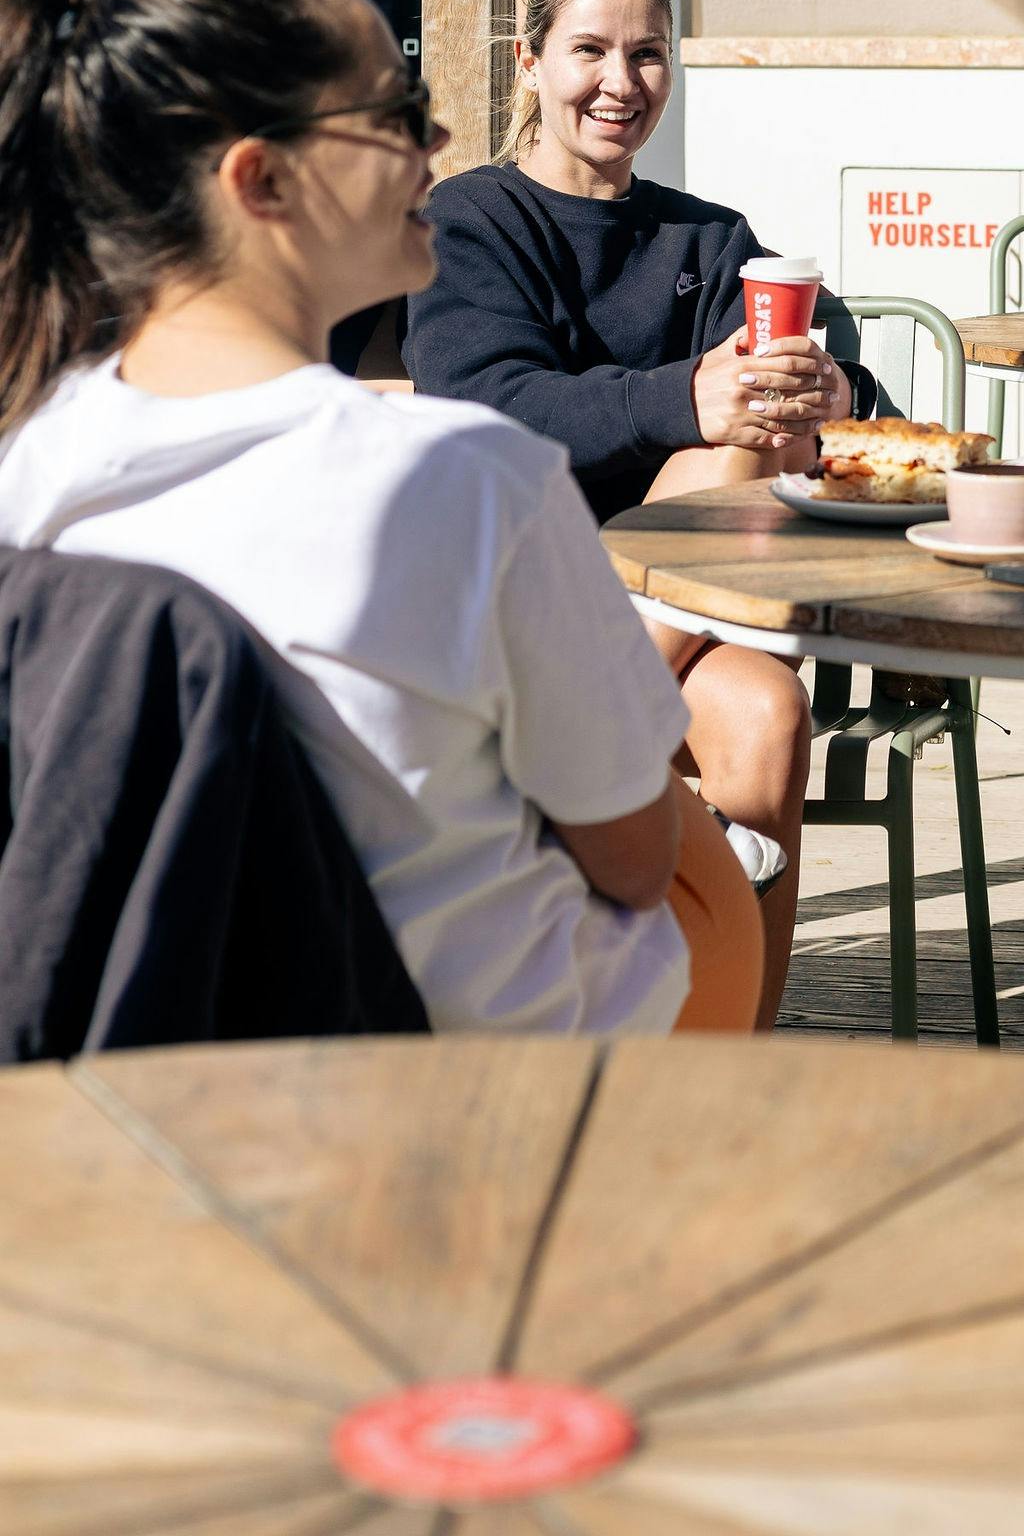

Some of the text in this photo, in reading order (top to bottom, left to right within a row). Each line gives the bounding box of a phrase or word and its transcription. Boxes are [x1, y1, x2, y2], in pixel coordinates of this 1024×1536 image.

[868, 191, 932, 215] HELP
[868, 222, 998, 247] YOURSELF
[754, 292, 773, 345] OSA'S
